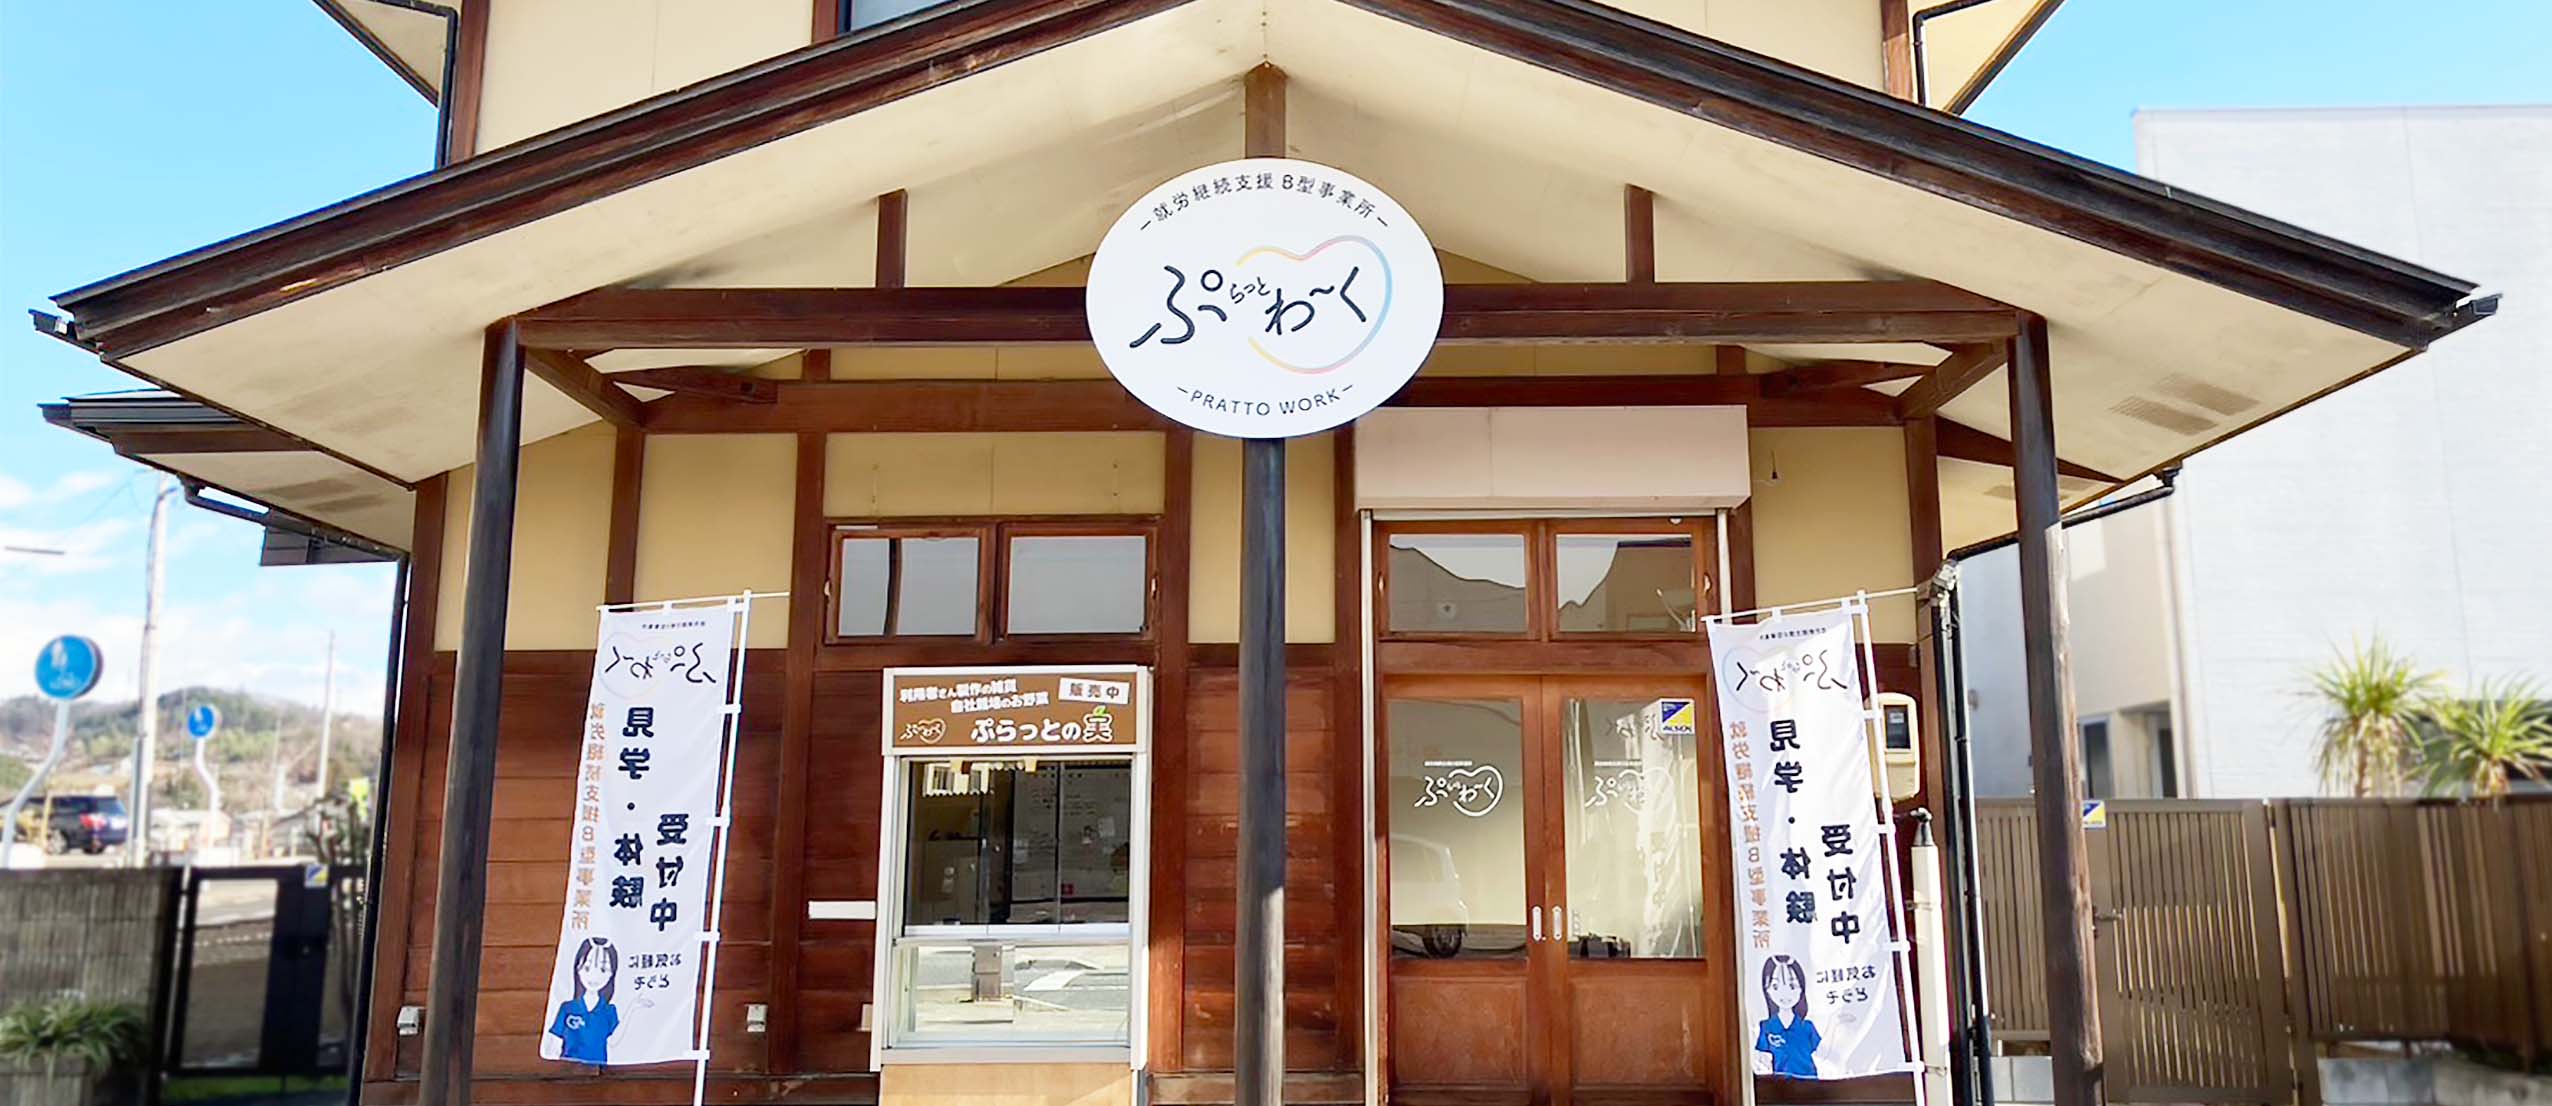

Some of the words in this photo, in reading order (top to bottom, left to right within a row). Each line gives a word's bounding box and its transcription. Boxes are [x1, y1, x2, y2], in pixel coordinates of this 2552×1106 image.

[1190, 390, 1271, 416] PRATTO
[1279, 388, 1342, 415] WORK
[969, 712, 1113, 744] ぷらっとの実
